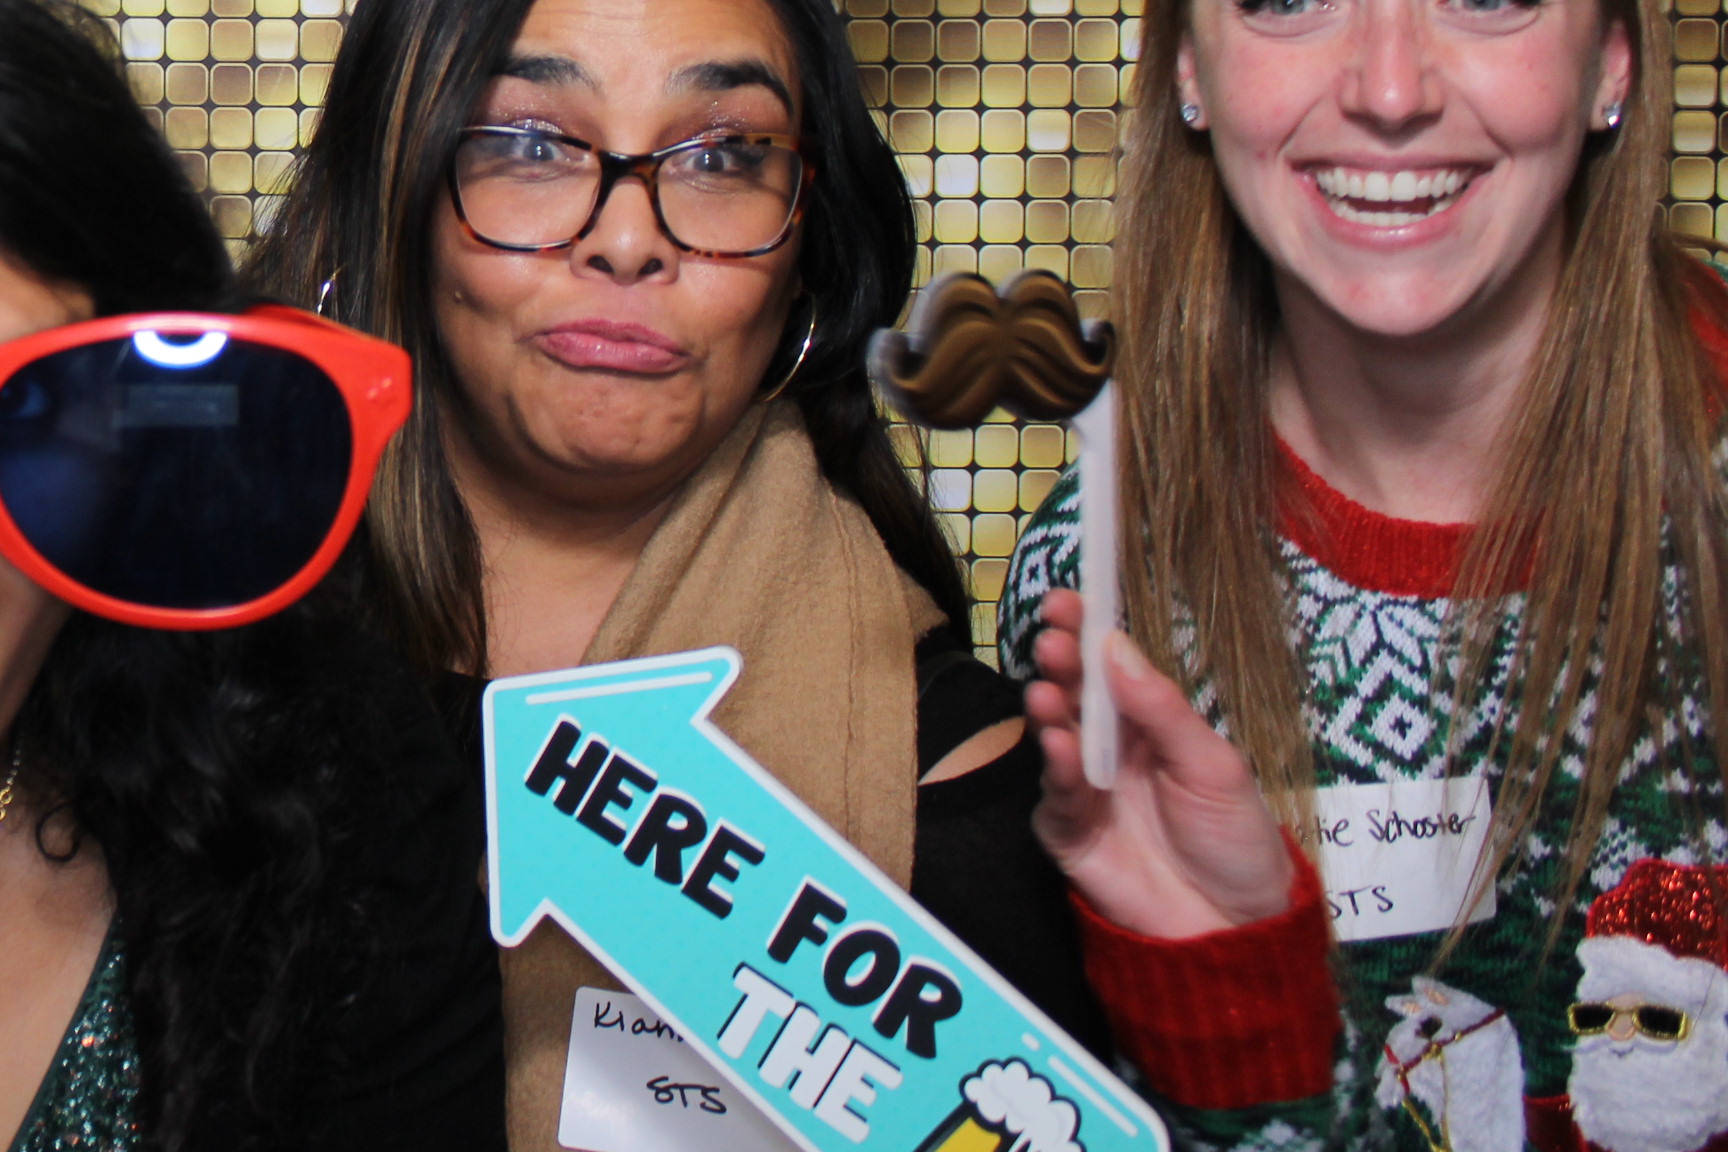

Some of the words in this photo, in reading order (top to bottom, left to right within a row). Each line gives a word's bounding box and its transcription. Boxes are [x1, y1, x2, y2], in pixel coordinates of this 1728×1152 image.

[524, 718, 766, 919] HERE
[768, 878, 963, 1059] FOR
[1325, 886, 1394, 920] STS
[594, 1001, 685, 1042] Kian
[717, 961, 903, 1145] THE
[646, 1076, 727, 1114] STS
